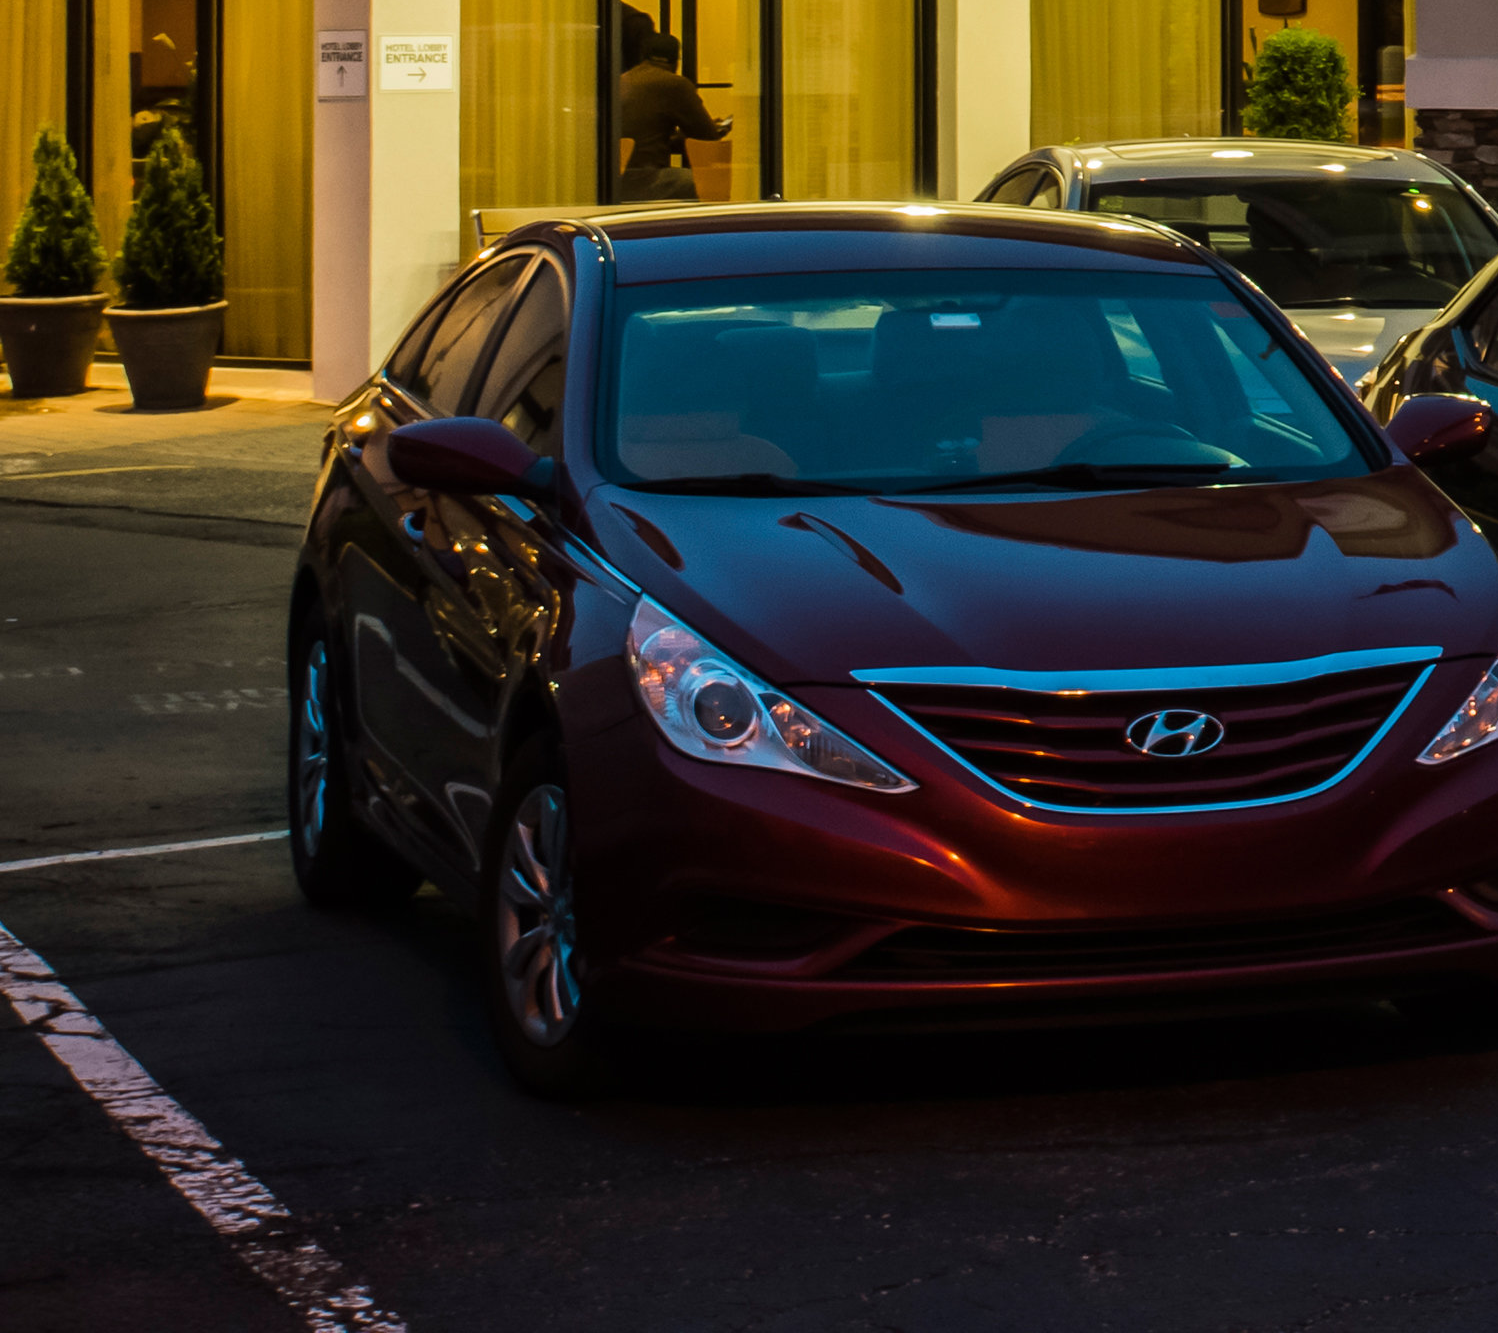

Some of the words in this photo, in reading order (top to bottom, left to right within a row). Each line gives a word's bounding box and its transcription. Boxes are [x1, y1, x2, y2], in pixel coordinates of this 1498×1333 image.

[321, 42, 341, 50] HOTEL
[343, 42, 362, 50] LOBBY
[386, 44, 415, 52] HOTEL
[418, 44, 447, 52] LOBBY
[321, 52, 362, 62] ENTRANCE
[386, 53, 447, 63] ENTRANCE
